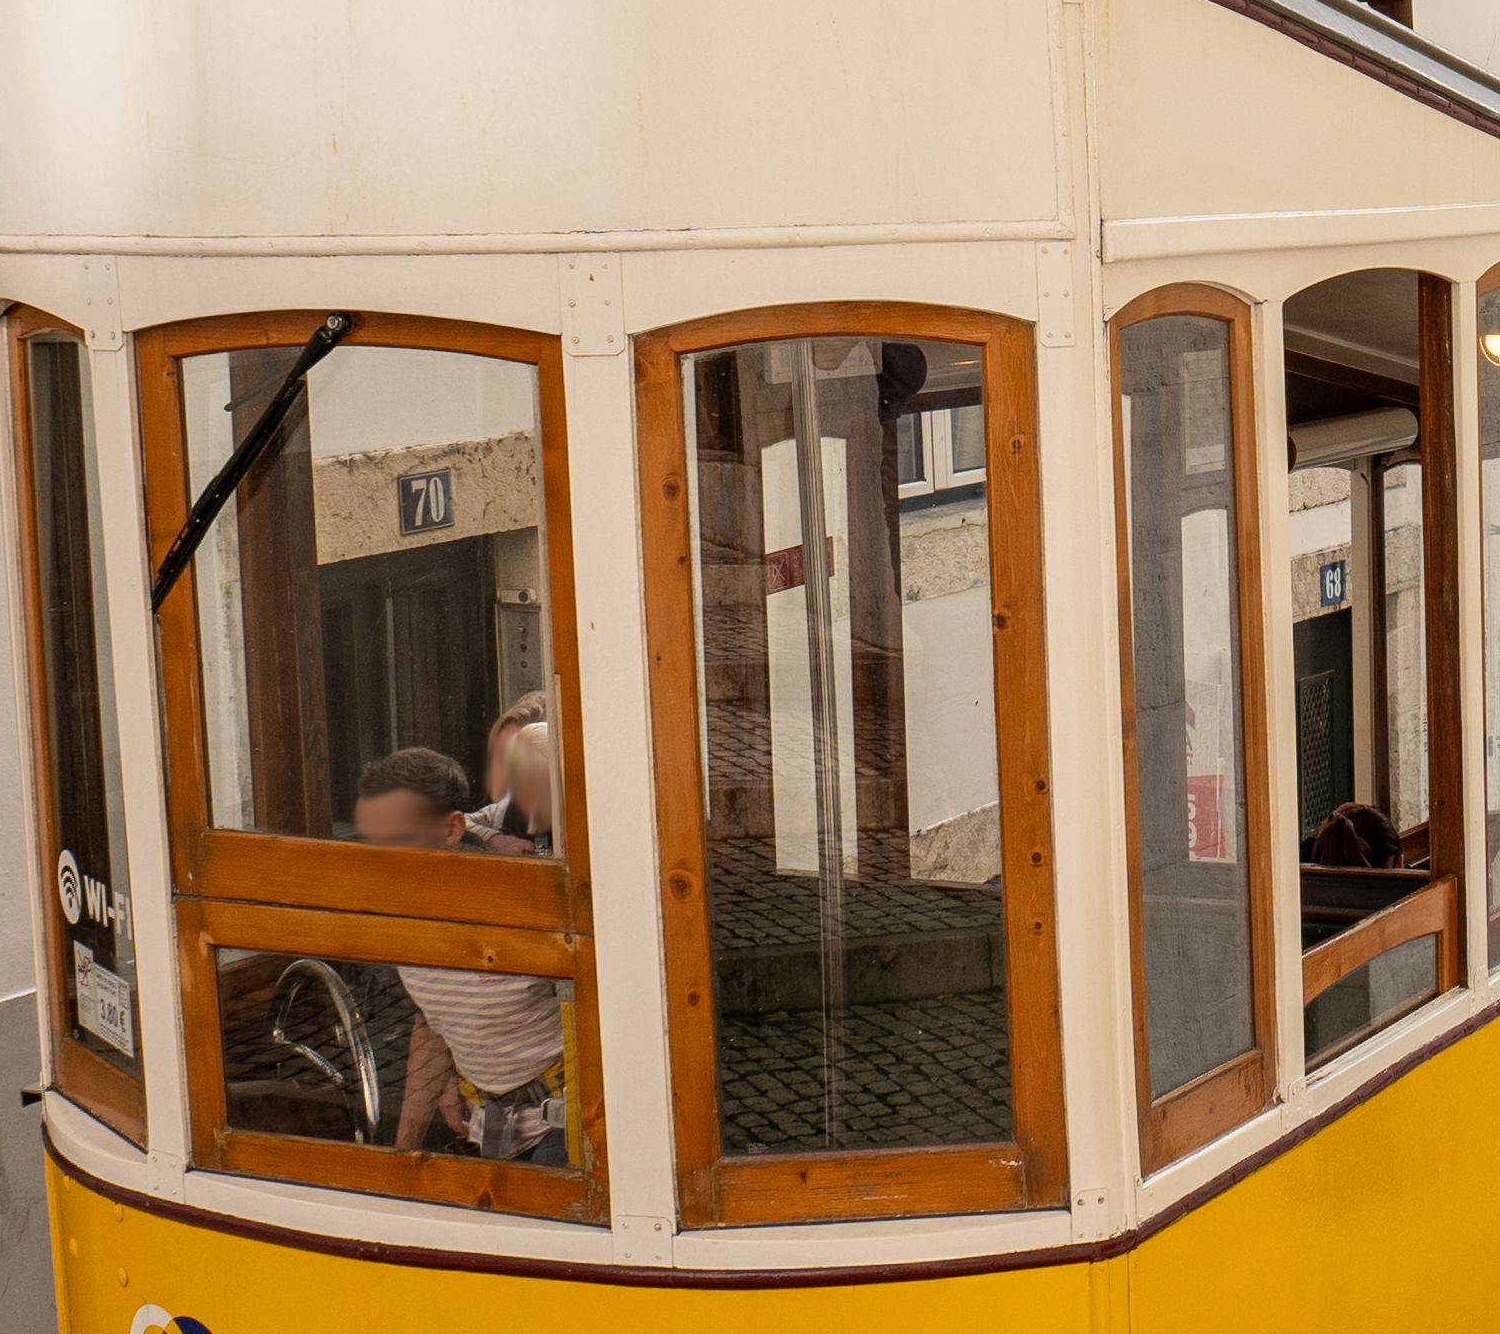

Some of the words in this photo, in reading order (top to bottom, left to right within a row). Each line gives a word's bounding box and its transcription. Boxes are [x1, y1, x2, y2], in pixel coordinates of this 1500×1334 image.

[411, 476, 445, 526] 70
[1325, 567, 1342, 599] 68
[83, 874, 133, 940] WI-FI
